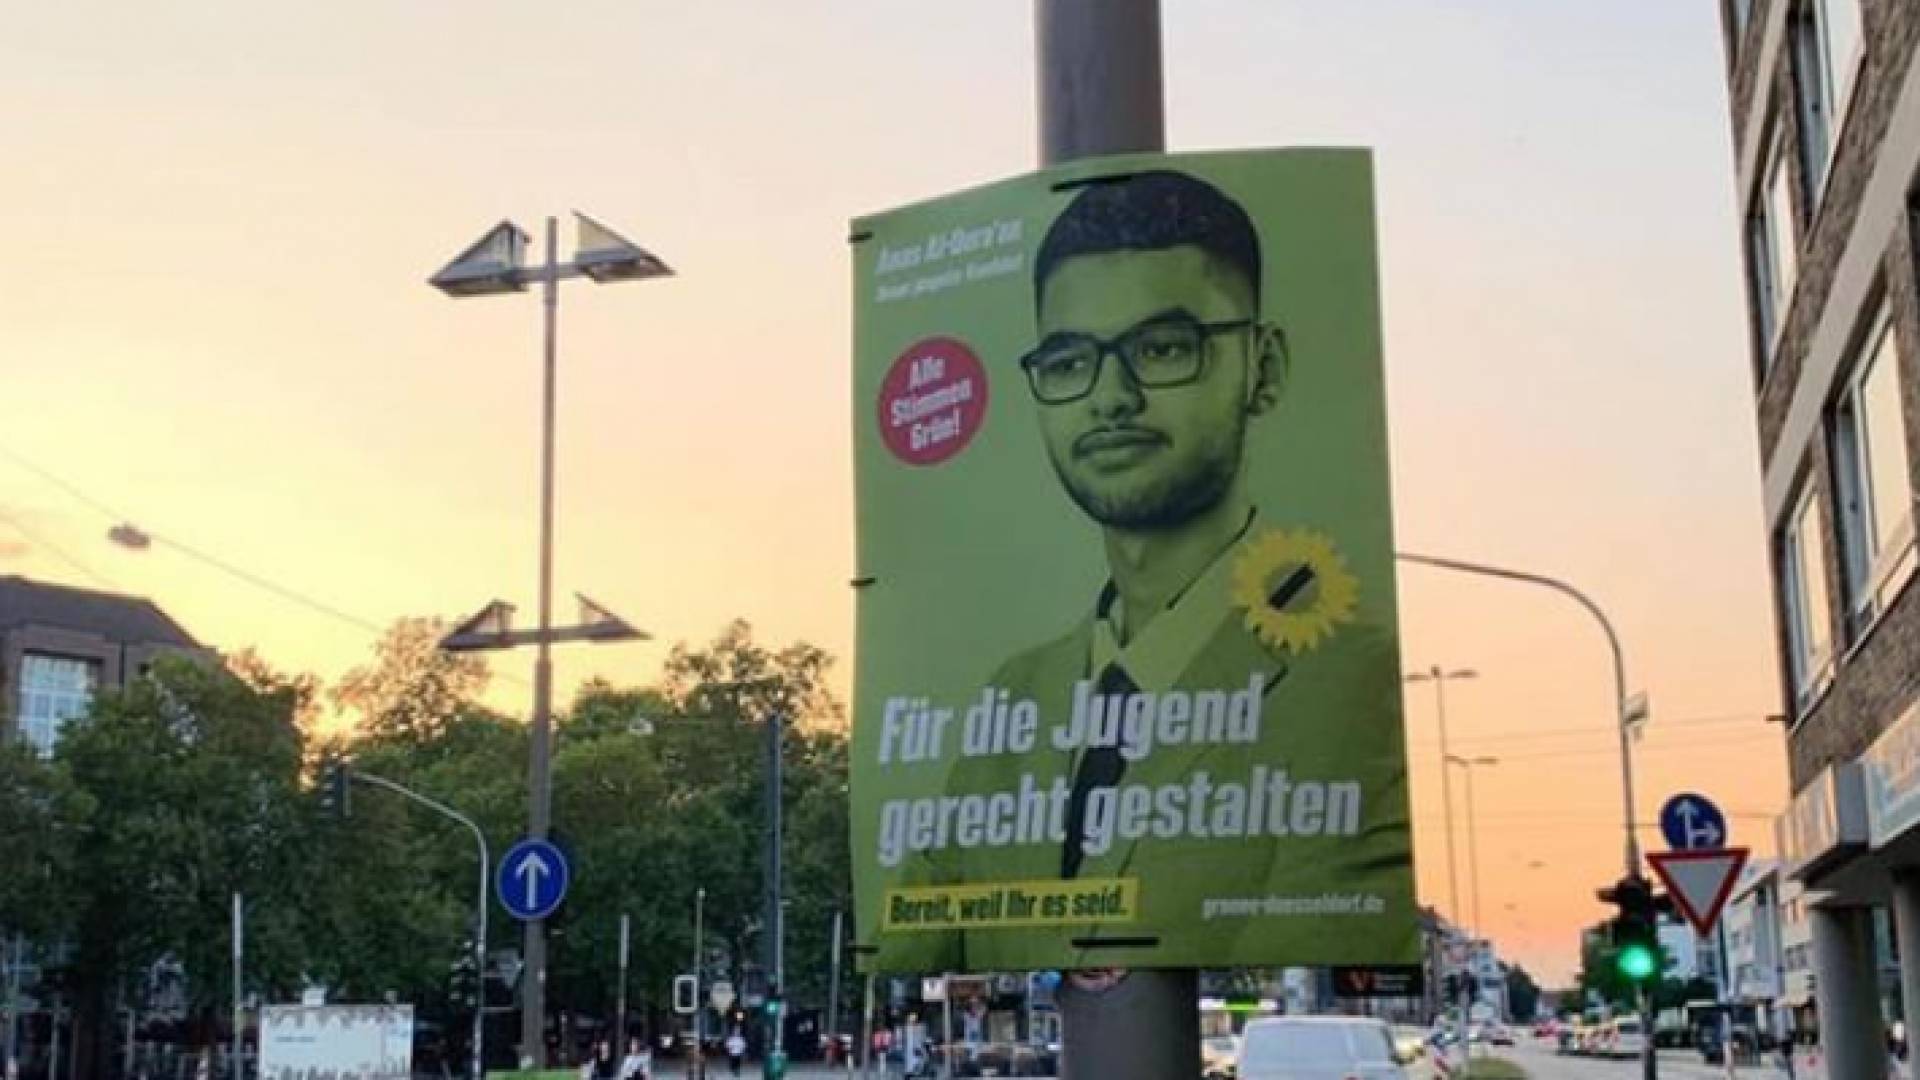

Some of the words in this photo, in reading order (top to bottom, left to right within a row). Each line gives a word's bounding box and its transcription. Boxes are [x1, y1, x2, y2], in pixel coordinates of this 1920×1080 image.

[910, 356, 945, 391] Alle
[891, 378, 973, 428] Stimmen
[910, 407, 960, 451] Grün!
[878, 694, 952, 766] Für
[963, 686, 1038, 756] die
[1052, 673, 1266, 760] Jugend
[878, 772, 1071, 867] gerecht
[1082, 764, 1361, 857] gestalten
[891, 893, 956, 924] Bereit,
[959, 890, 1003, 919] weil
[1006, 888, 1037, 917] Ihr
[1041, 892, 1068, 916] es
[1071, 885, 1128, 916] seid.
